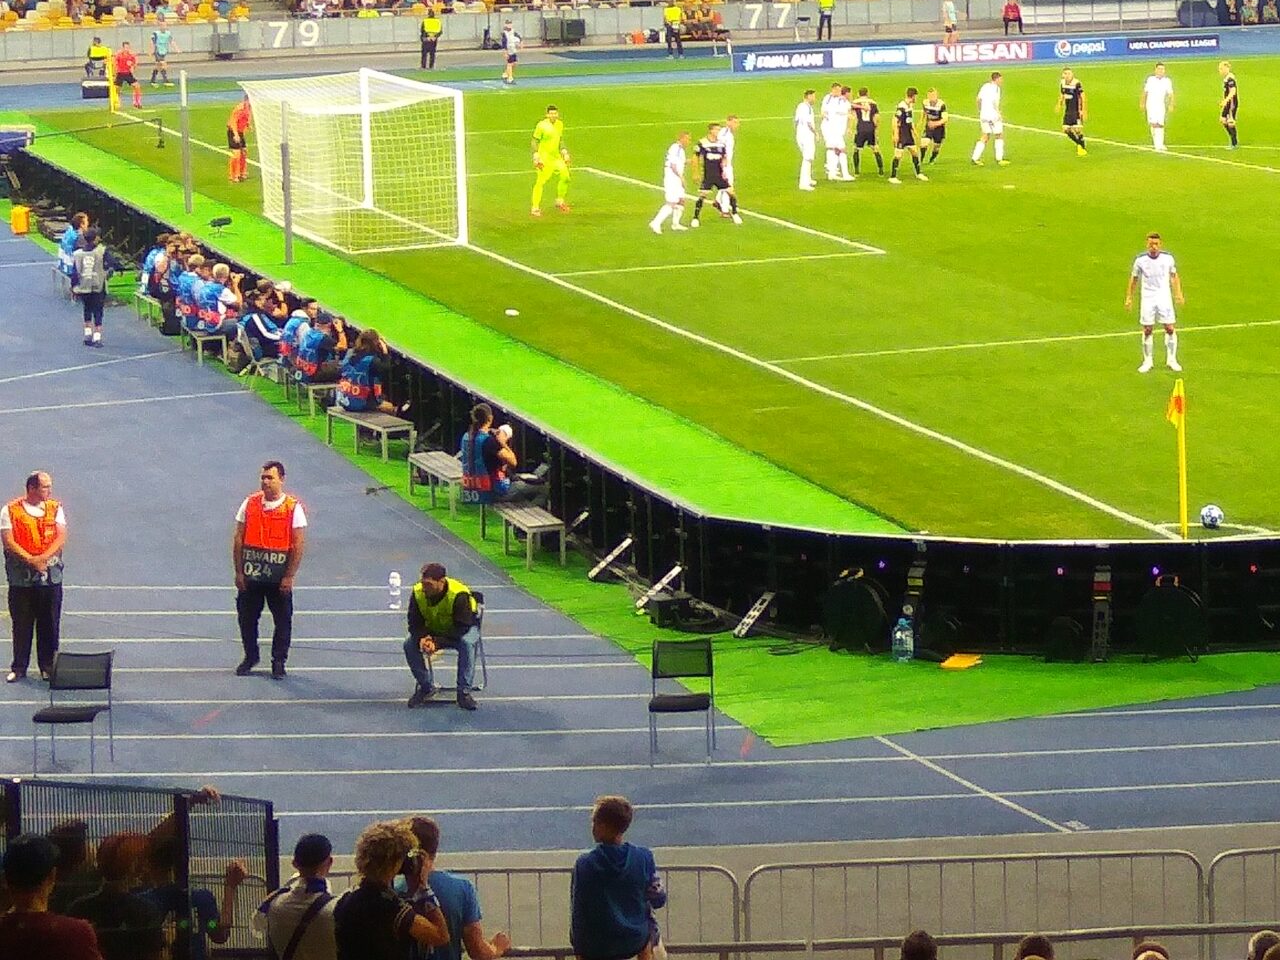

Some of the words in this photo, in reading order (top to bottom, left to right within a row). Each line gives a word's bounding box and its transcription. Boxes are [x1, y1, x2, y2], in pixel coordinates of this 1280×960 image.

[745, 3, 791, 29] 77
[268, 20, 320, 48] 79
[938, 42, 1028, 63] NISSAN
[1072, 40, 1107, 56] pepsi
[1129, 41, 1149, 50] UEFA
[1149, 40, 1190, 49] CHAMPIONS
[1190, 38, 1217, 47] LEAGUE
[243, 561, 273, 577] 024
